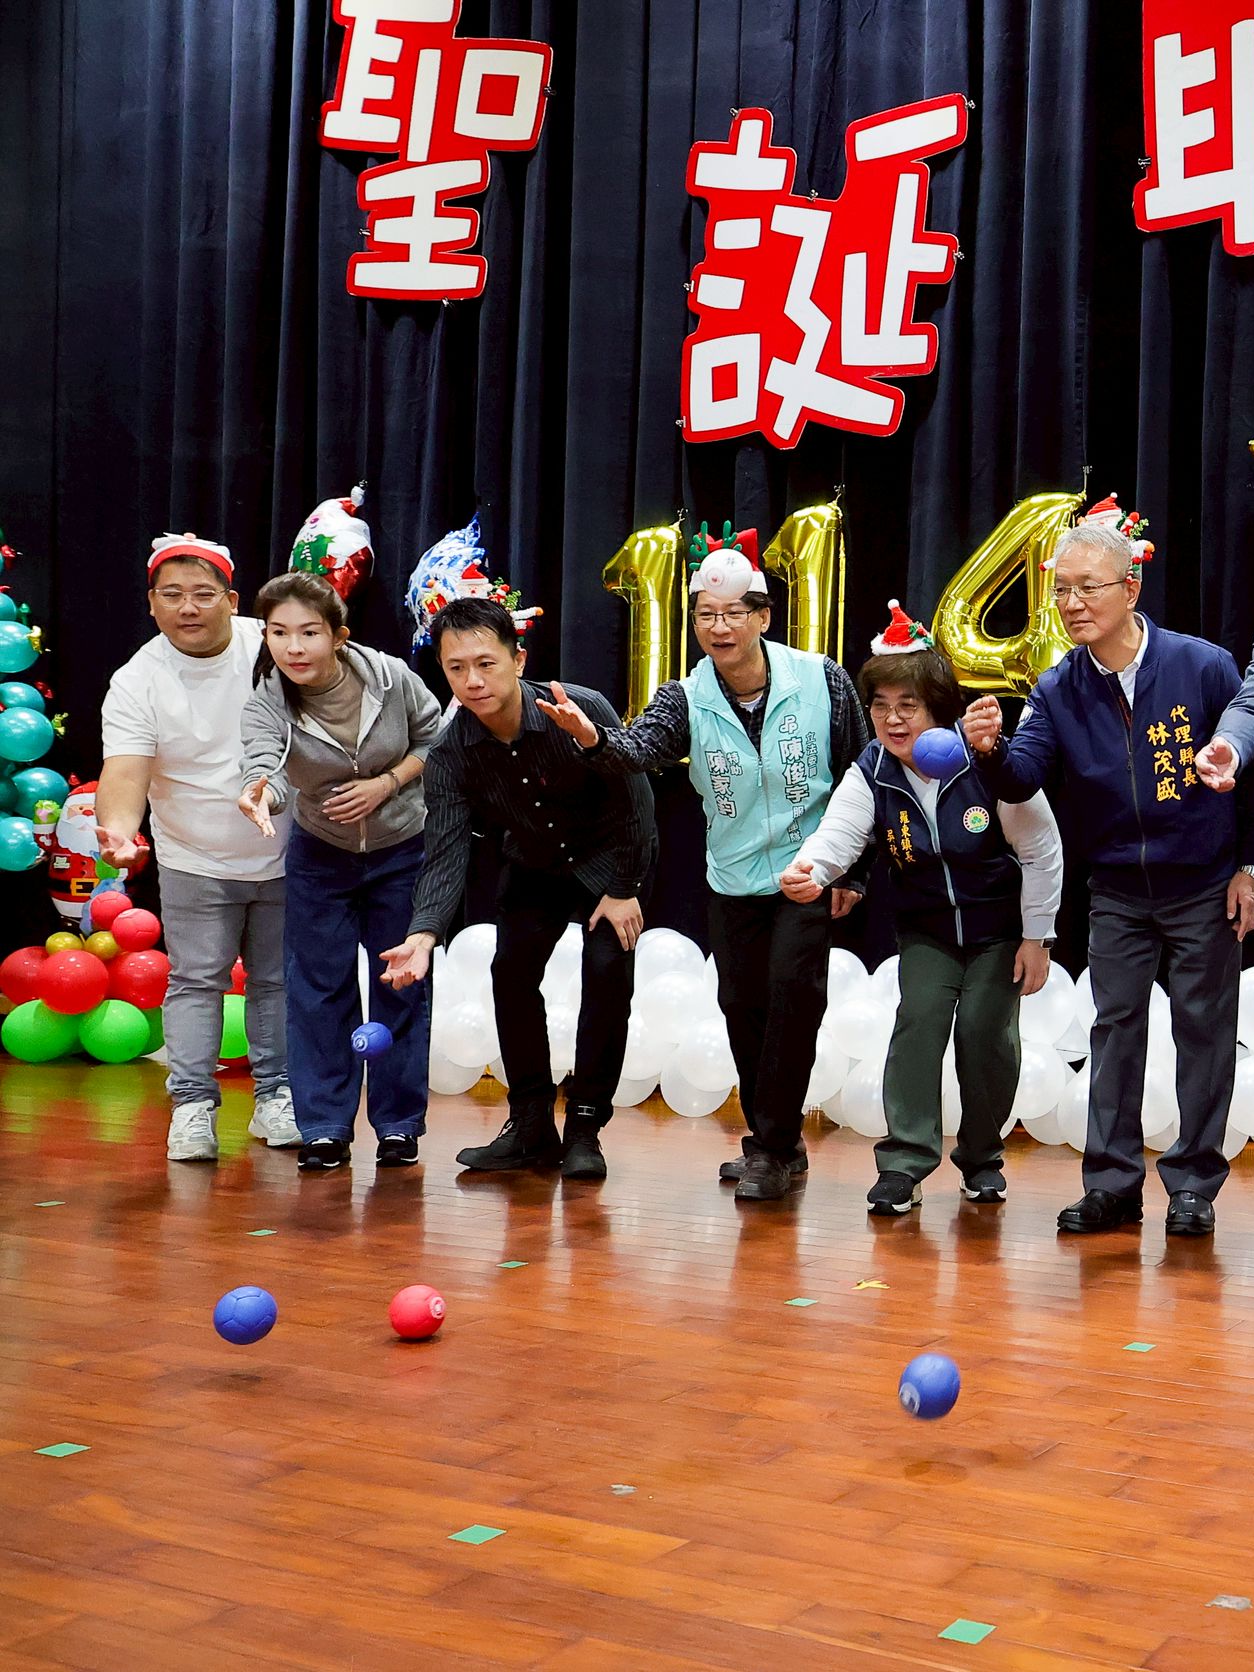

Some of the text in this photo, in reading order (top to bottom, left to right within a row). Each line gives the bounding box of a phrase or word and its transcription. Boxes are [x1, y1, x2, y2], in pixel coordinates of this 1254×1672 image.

[778, 736, 810, 804] 陳俊宇
[1146, 721, 1181, 802] 林茂盛
[1169, 704, 1198, 788] 代理縣長
